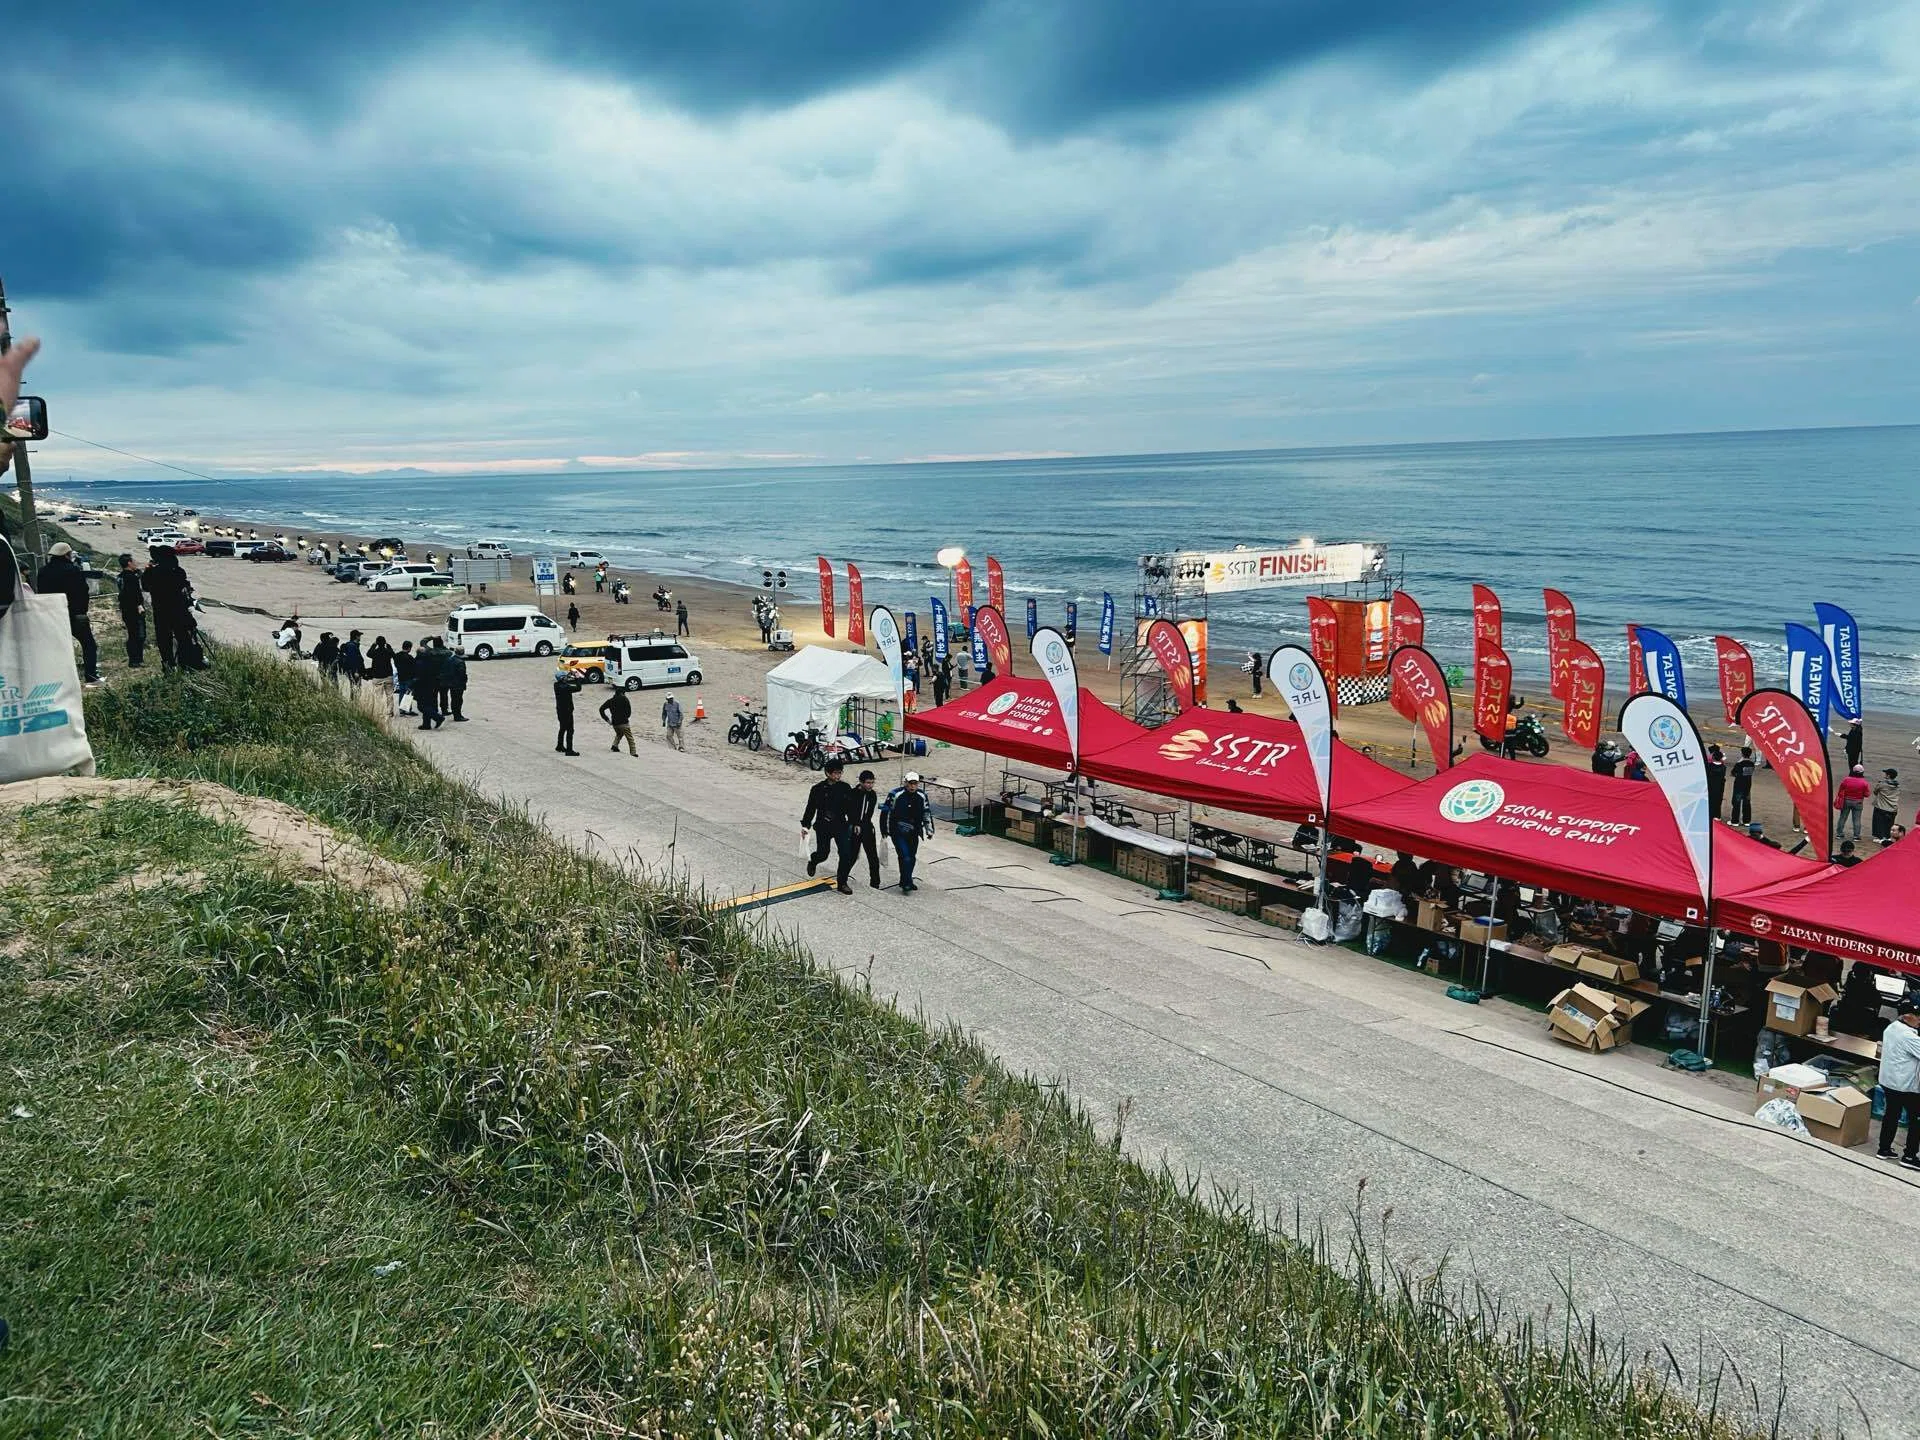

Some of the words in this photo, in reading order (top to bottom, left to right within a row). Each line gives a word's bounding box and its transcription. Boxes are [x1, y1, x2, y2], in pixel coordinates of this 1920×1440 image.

[1228, 560, 1257, 575] SSTR
[1259, 554, 1327, 576] FINISH
[1014, 703, 1050, 716] RIDERS
[1020, 696, 1054, 709] JAPAN
[1008, 710, 1041, 723] FORUM
[1211, 733, 1290, 767] SSTR
[1495, 815, 1564, 837] TOURING
[1565, 830, 1617, 846] RALLY
[1503, 804, 1553, 820] SOCIAL
[1557, 815, 1641, 836] SUPPORT
[1780, 925, 1823, 943] JAPAN
[1825, 934, 1874, 955] RIDERS
